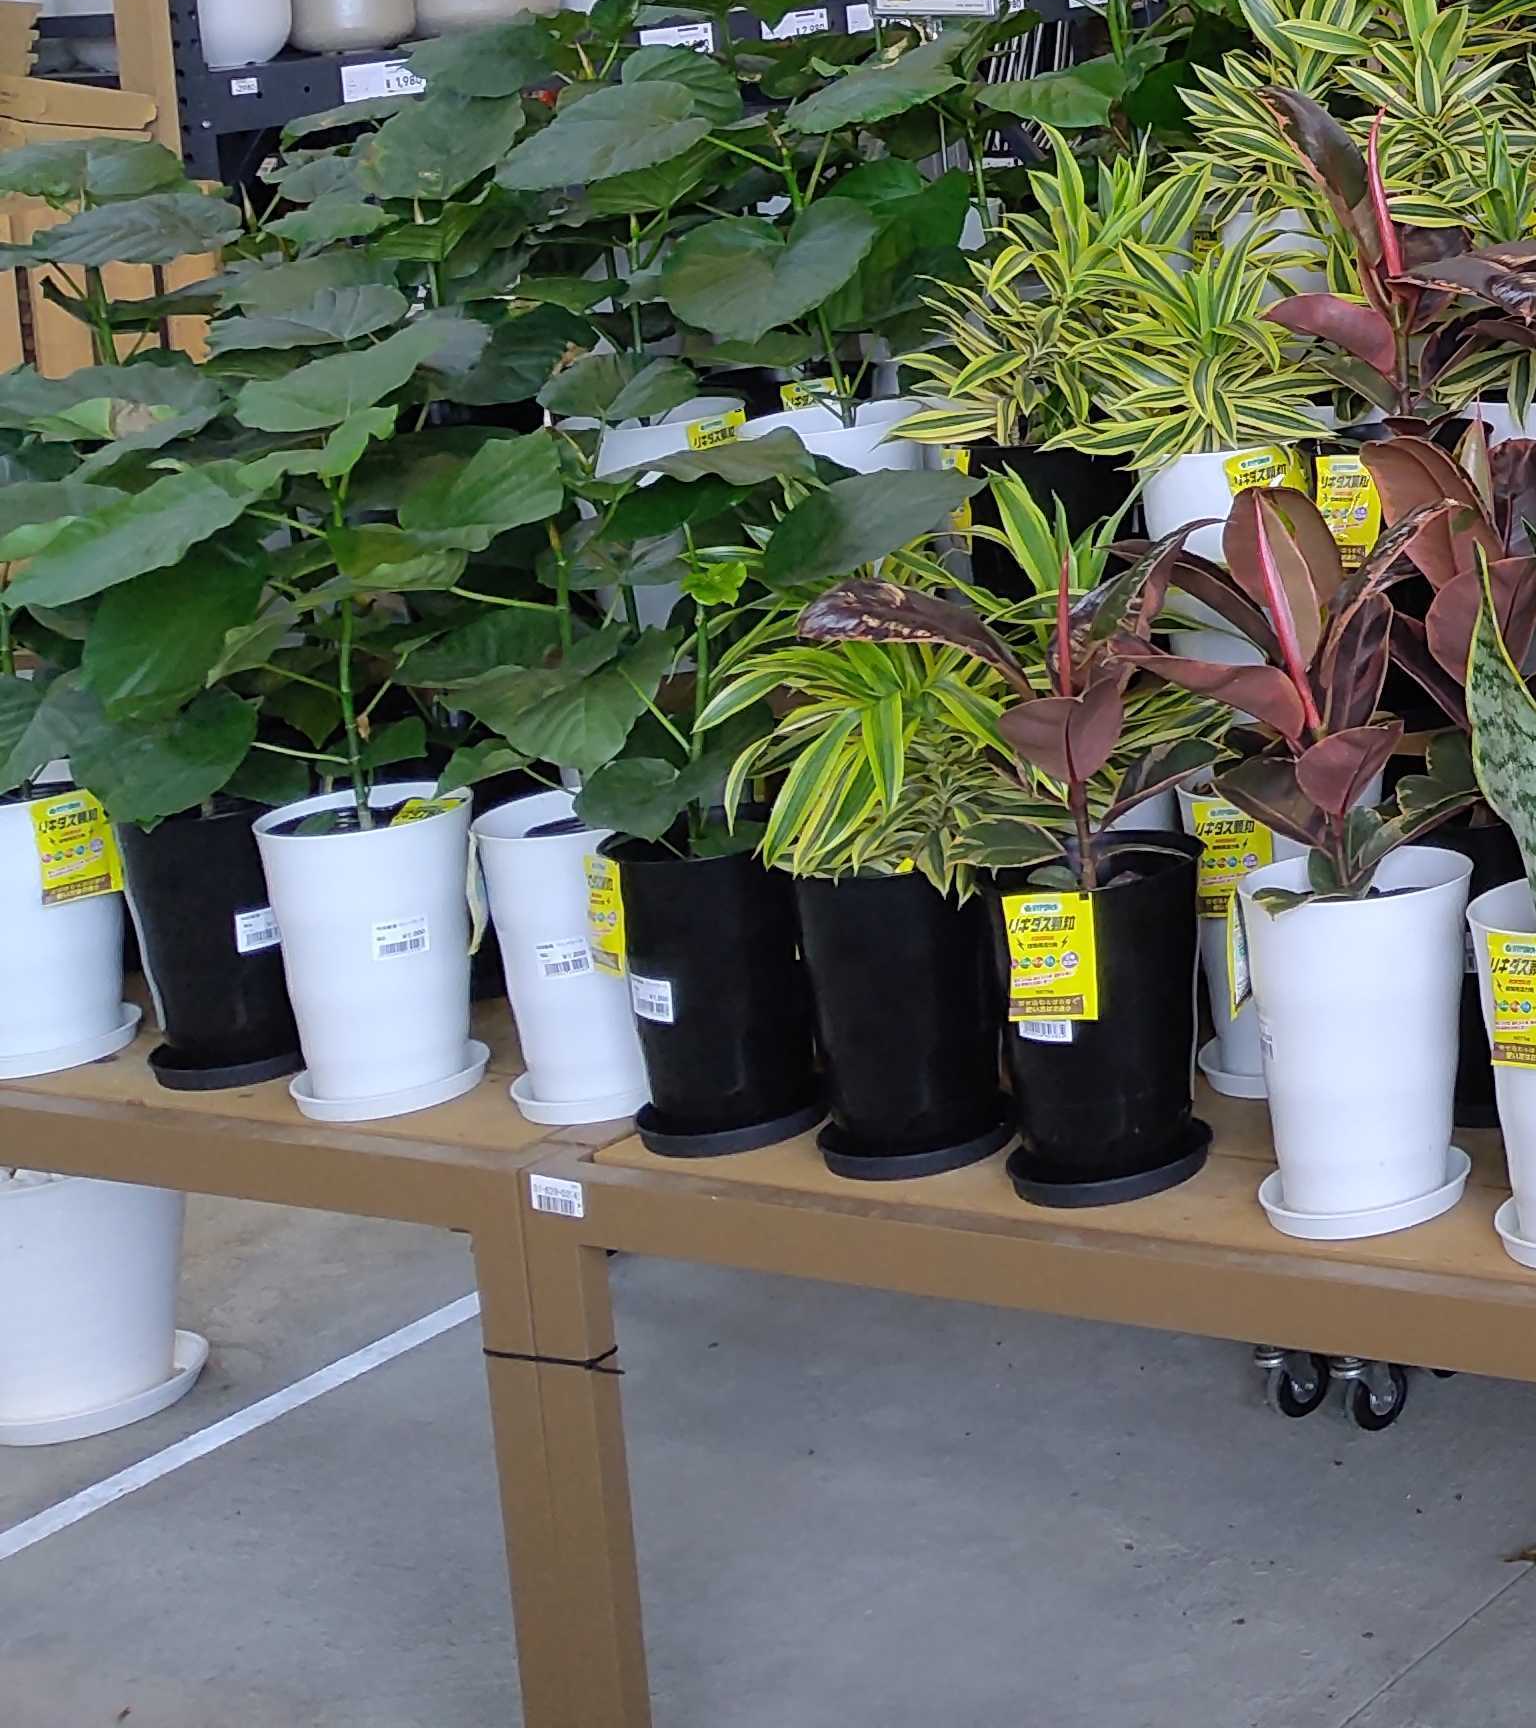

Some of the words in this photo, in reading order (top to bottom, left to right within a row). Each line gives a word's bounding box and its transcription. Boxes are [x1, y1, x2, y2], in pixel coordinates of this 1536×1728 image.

[1195, 819, 1255, 837] リキダス顆粒
[1008, 915, 1076, 934] リキダス顆粒
